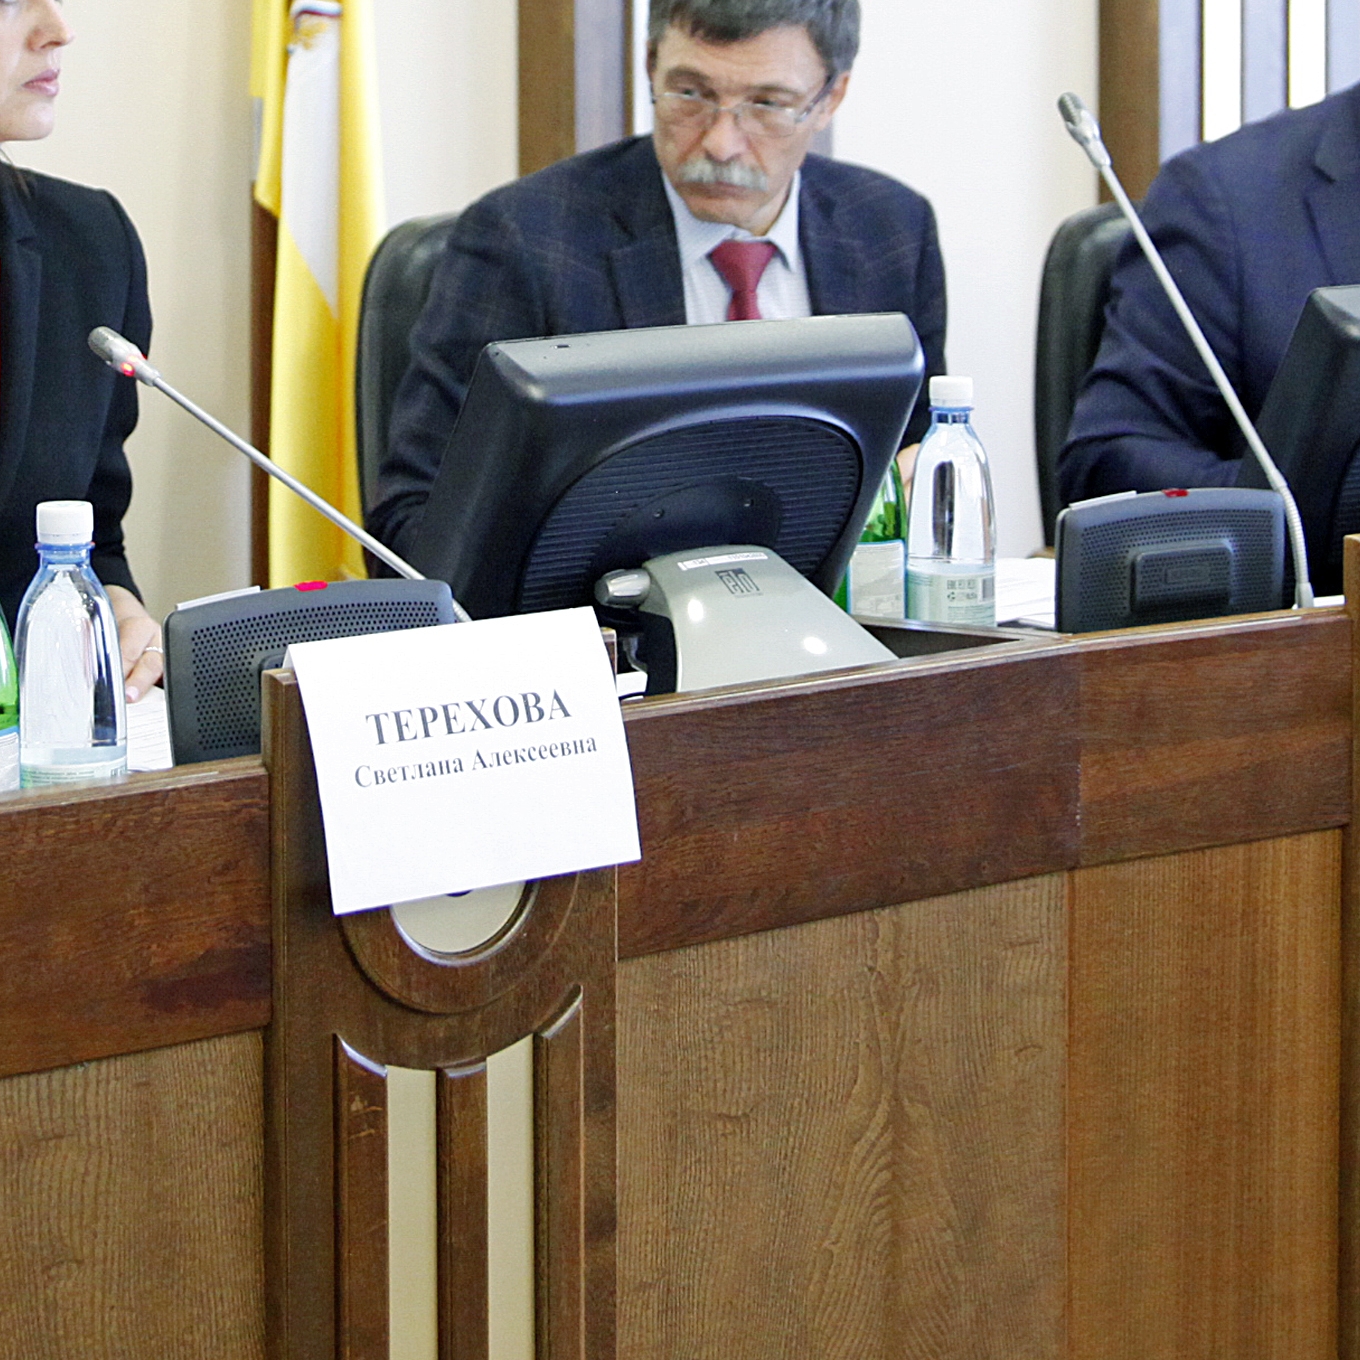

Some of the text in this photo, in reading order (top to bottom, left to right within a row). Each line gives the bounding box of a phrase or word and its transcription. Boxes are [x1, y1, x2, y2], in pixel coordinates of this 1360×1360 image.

[365, 688, 572, 746] ТЕРЕХОВА
[354, 736, 598, 788] Светлана Алексеевна
